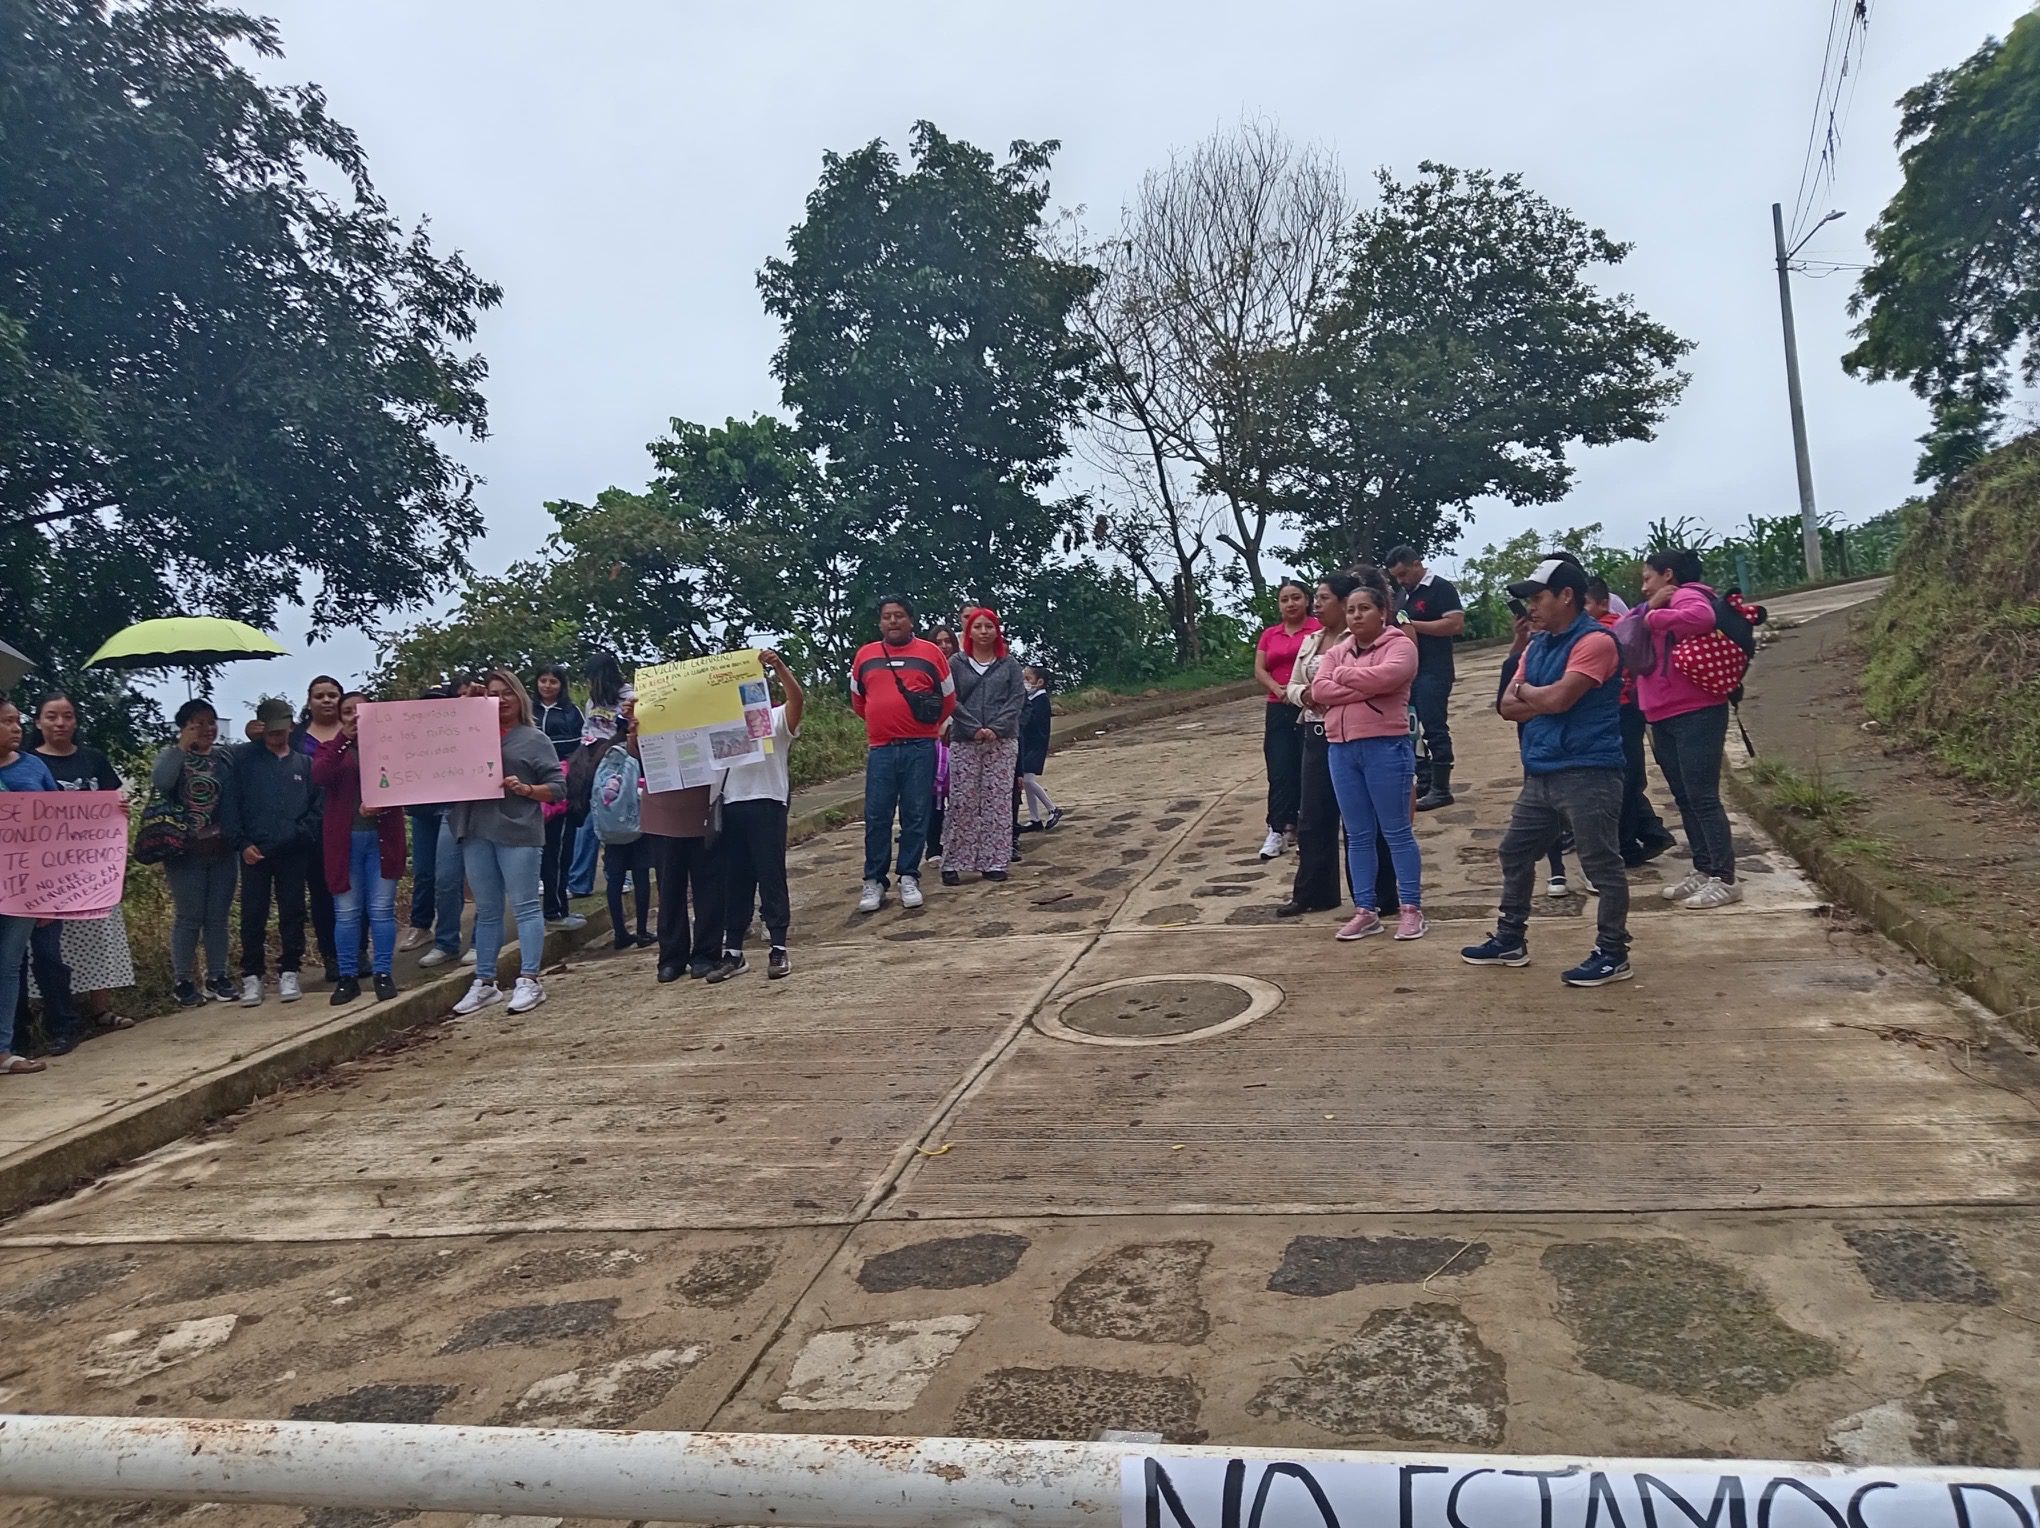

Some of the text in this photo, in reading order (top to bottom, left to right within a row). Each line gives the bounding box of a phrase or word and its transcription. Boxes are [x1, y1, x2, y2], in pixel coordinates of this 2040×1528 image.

[653, 661, 686, 675] VICENTE
[375, 709, 392, 723] La
[380, 733, 392, 743] de
[400, 730, 416, 740] los
[33, 799, 113, 821] DOMINGO
[4, 846, 125, 870] TE QUEREMOS
[24, 863, 118, 910] BIENVENIDO EN
[36, 869, 92, 891] NO ERES
[1143, 1456, 1342, 1528] NO
